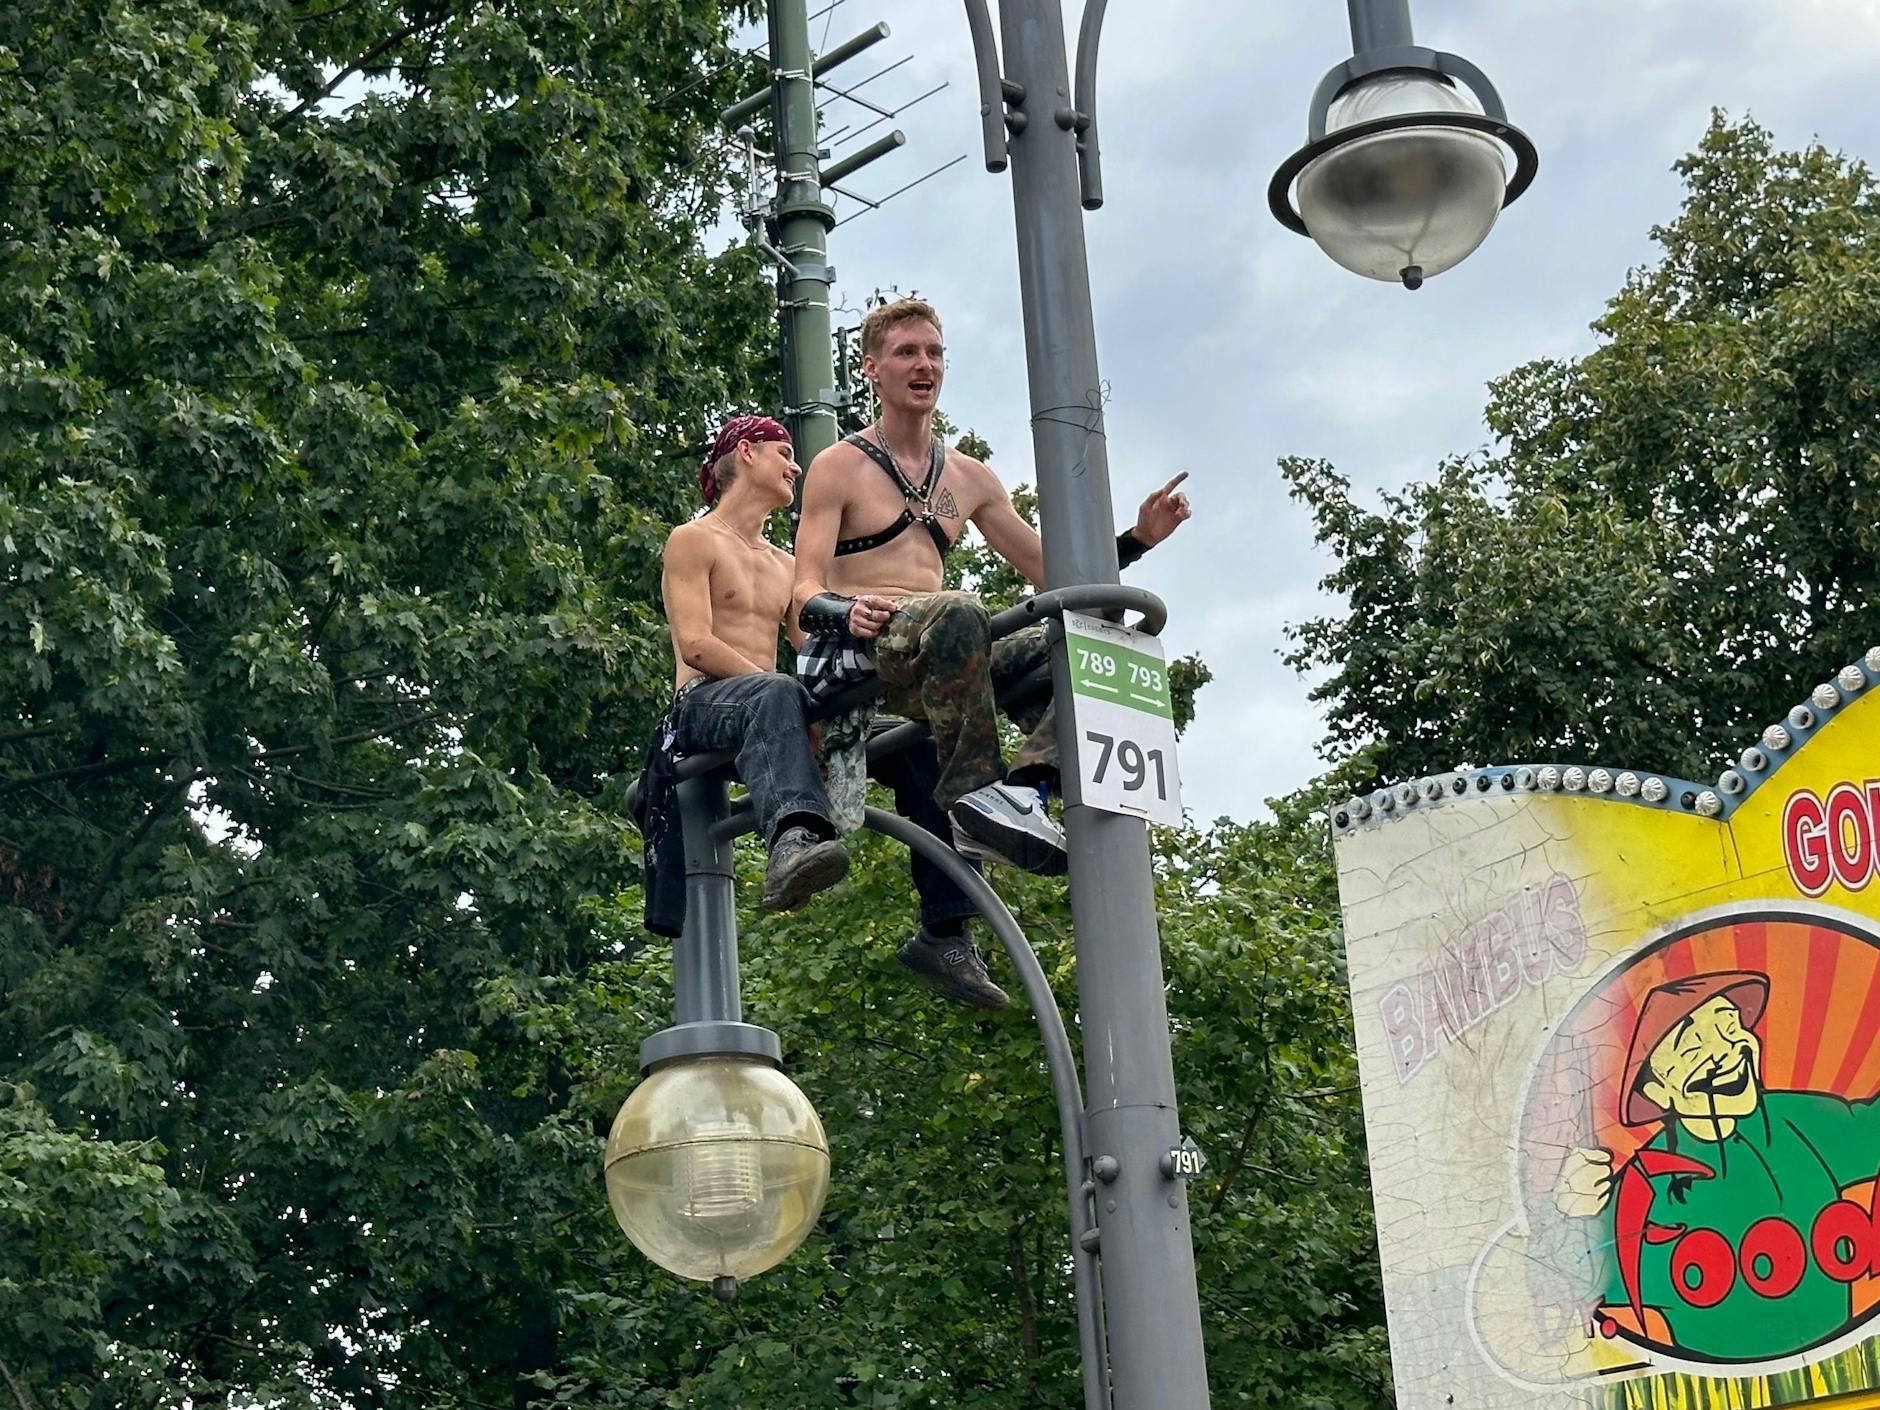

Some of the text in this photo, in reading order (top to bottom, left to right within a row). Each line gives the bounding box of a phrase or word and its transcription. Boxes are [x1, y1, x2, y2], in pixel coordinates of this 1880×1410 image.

[1076, 648, 1163, 692] 789 793
[1086, 730, 1167, 801] 791
[943, 949, 965, 966] N
[1378, 871, 1587, 1086] BAMBUS
[1170, 1150, 1200, 1174] 791
